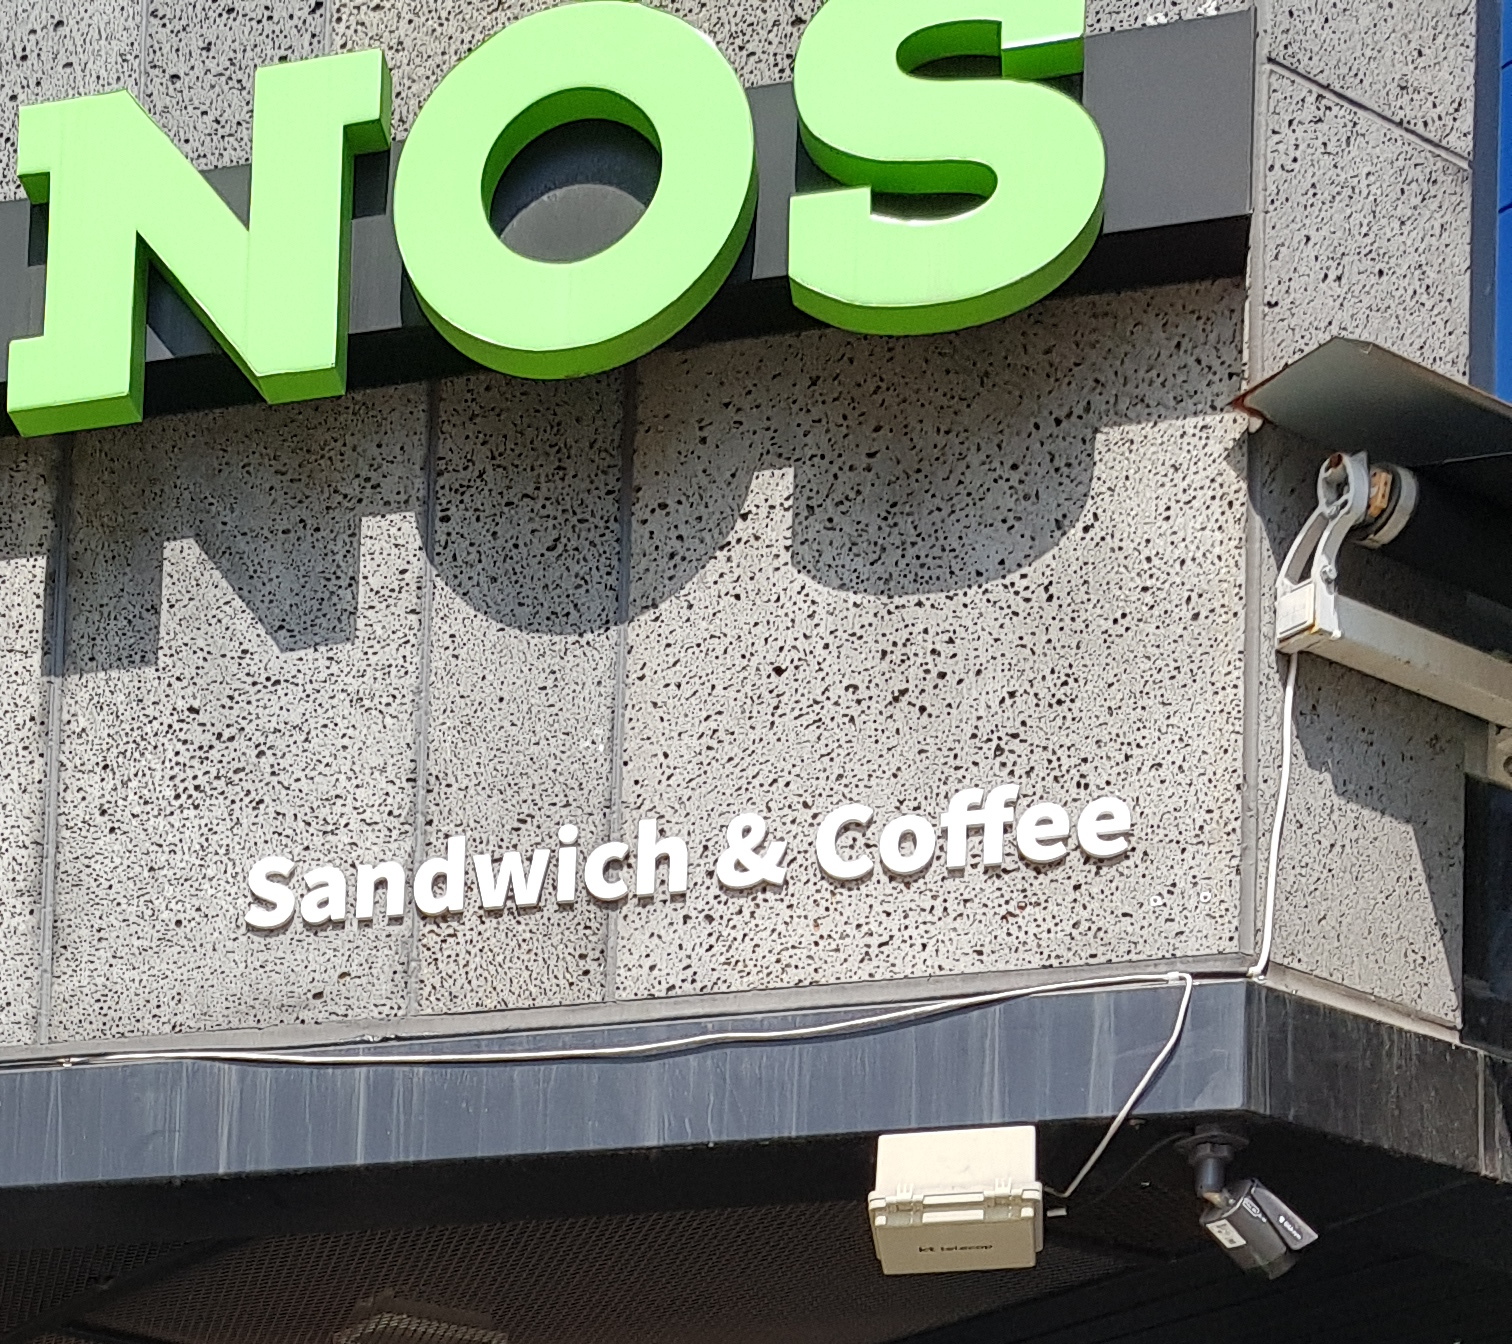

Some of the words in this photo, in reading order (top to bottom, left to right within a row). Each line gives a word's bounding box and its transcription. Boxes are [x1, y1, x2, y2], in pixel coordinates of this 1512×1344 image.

[244, 820, 689, 931] Sandwich
[716, 812, 787, 891] &
[815, 784, 1133, 881] Coffee
